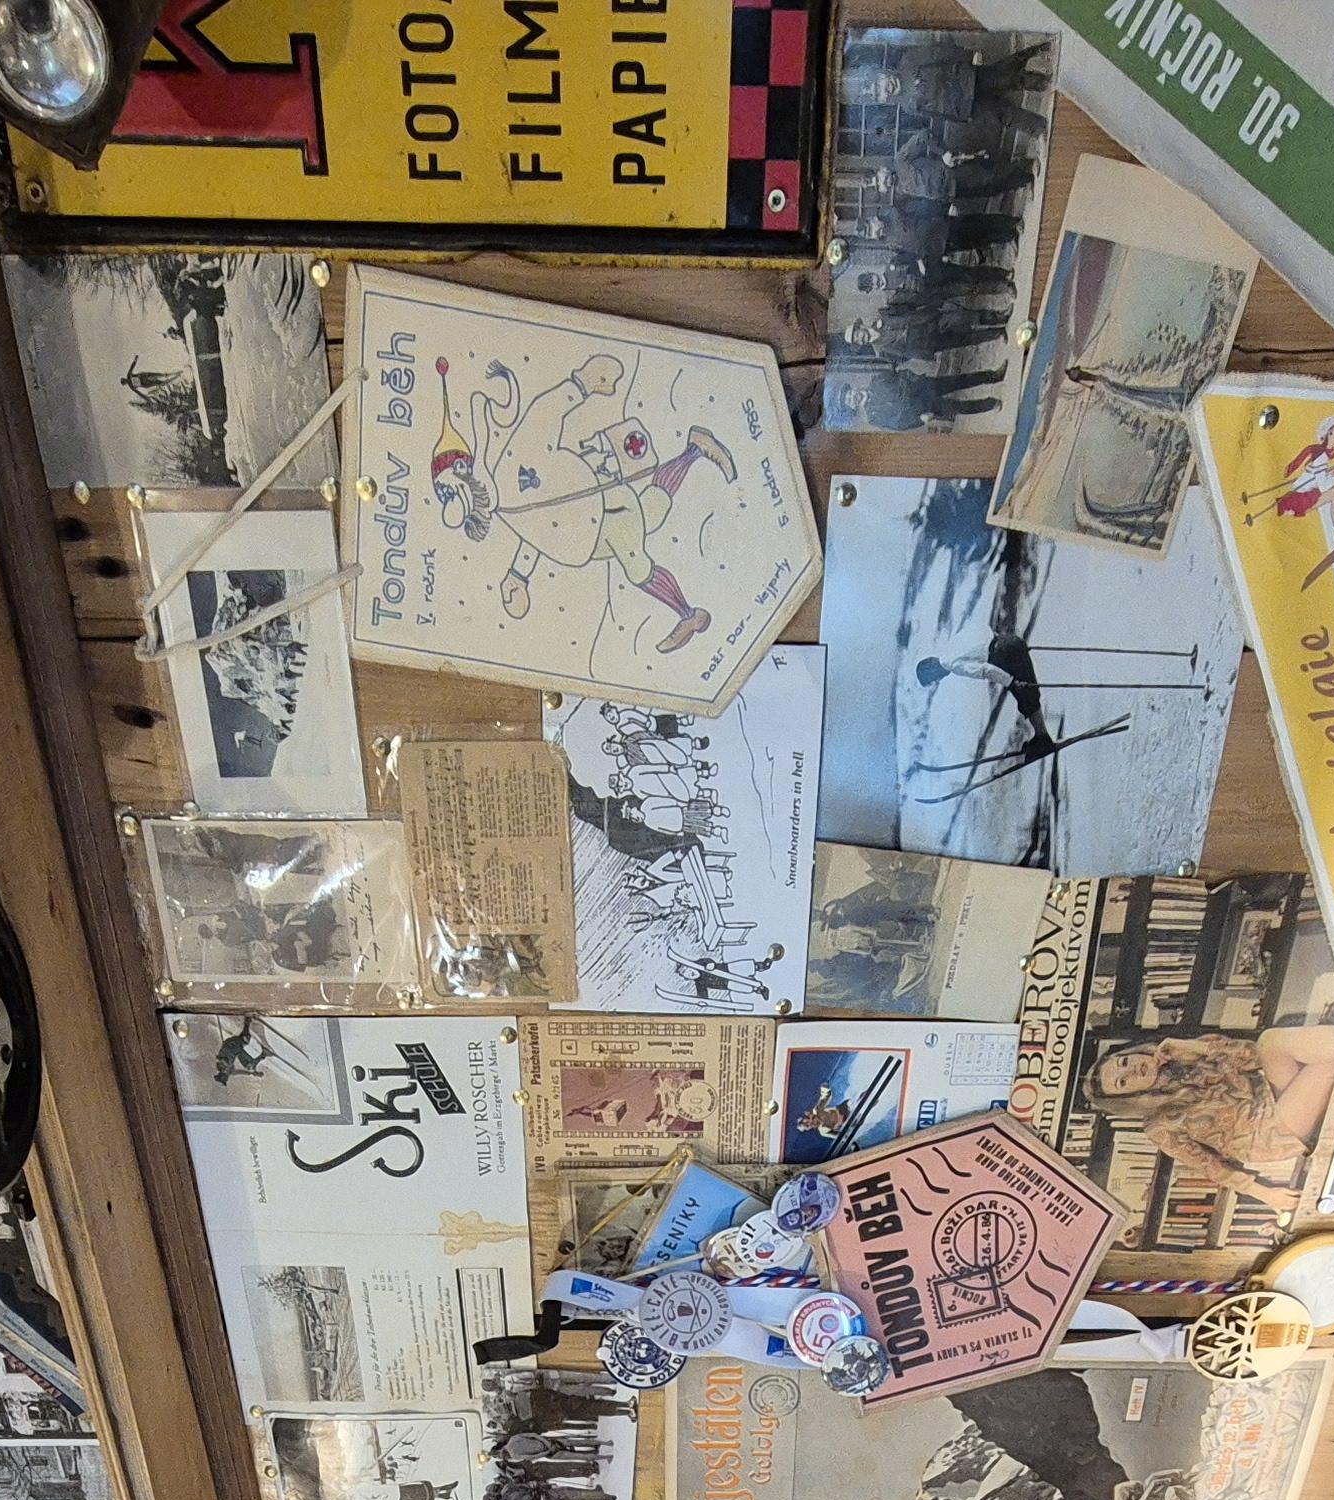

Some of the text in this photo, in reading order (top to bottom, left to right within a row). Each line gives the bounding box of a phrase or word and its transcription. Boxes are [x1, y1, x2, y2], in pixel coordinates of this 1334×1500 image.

[1237, 74, 1302, 164] 30.
[740, 397, 764, 444] 1985
[370, 330, 416, 627] Tondův běh
[788, 780, 803, 795] in
[783, 798, 803, 889] Snowboarders
[945, 944, 962, 990] POZDRAV
[1042, 879, 1092, 1089] fotoobjektívom
[526, 1021, 543, 1086] Patscherkofel
[400, 1042, 460, 1113] SCHULE
[283, 1064, 425, 1178] Ski
[467, 1039, 493, 1177] WILLY ROSCHER
[534, 1155, 546, 1173] IVB
[939, 1199, 999, 1245] BOŽÍ DAR
[1053, 1190, 1085, 1217] KOLEM
[1017, 1232, 1028, 1246] VE
[843, 1170, 935, 1379] TONDŮV BĚH
[946, 1299, 958, 1312] 6.
[811, 1313, 840, 1350] 50
[986, 1329, 1019, 1348] SLAVIA
